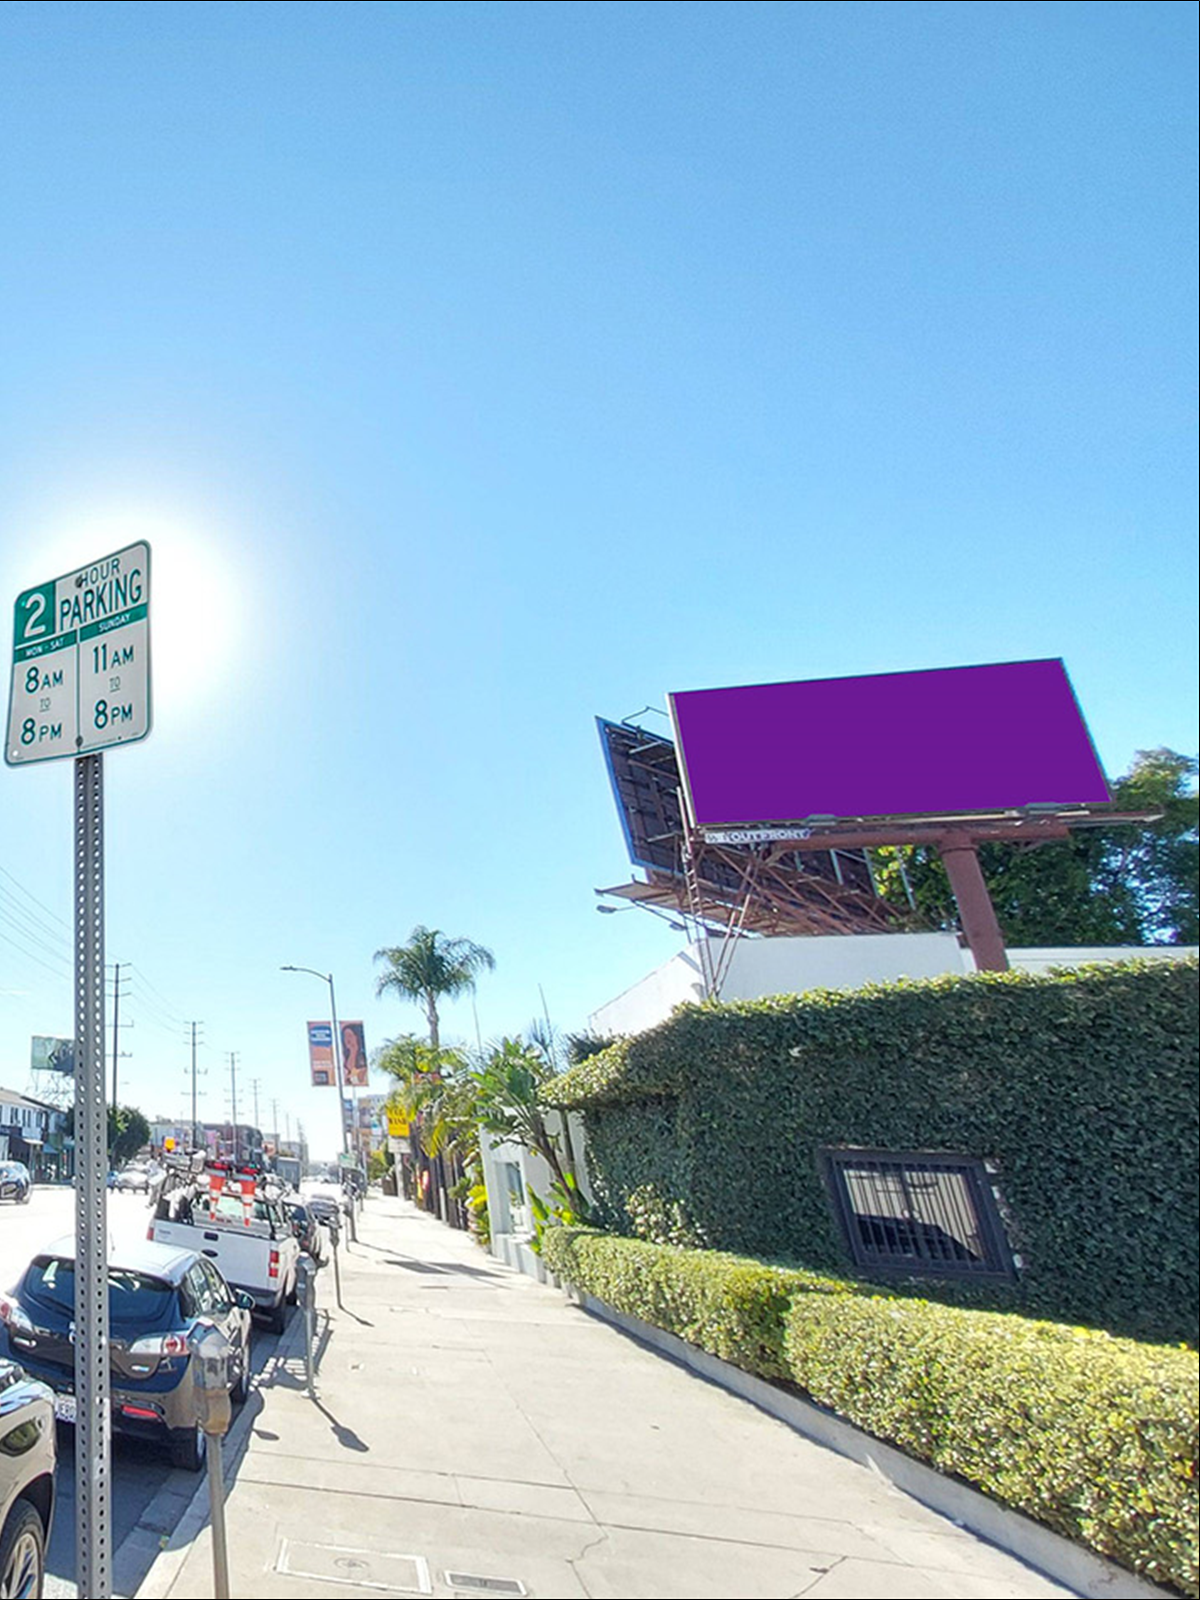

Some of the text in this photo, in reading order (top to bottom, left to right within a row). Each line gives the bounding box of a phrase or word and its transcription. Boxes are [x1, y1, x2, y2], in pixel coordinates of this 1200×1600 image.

[81, 557, 121, 587] HOUR
[59, 568, 143, 632] PARKING
[24, 592, 47, 638] 2
[98, 613, 132, 632] SUNDAY
[25, 642, 43, 657] MON
[50, 637, 65, 652] SAT
[109, 676, 121, 692] TO
[39, 697, 51, 712] TO
